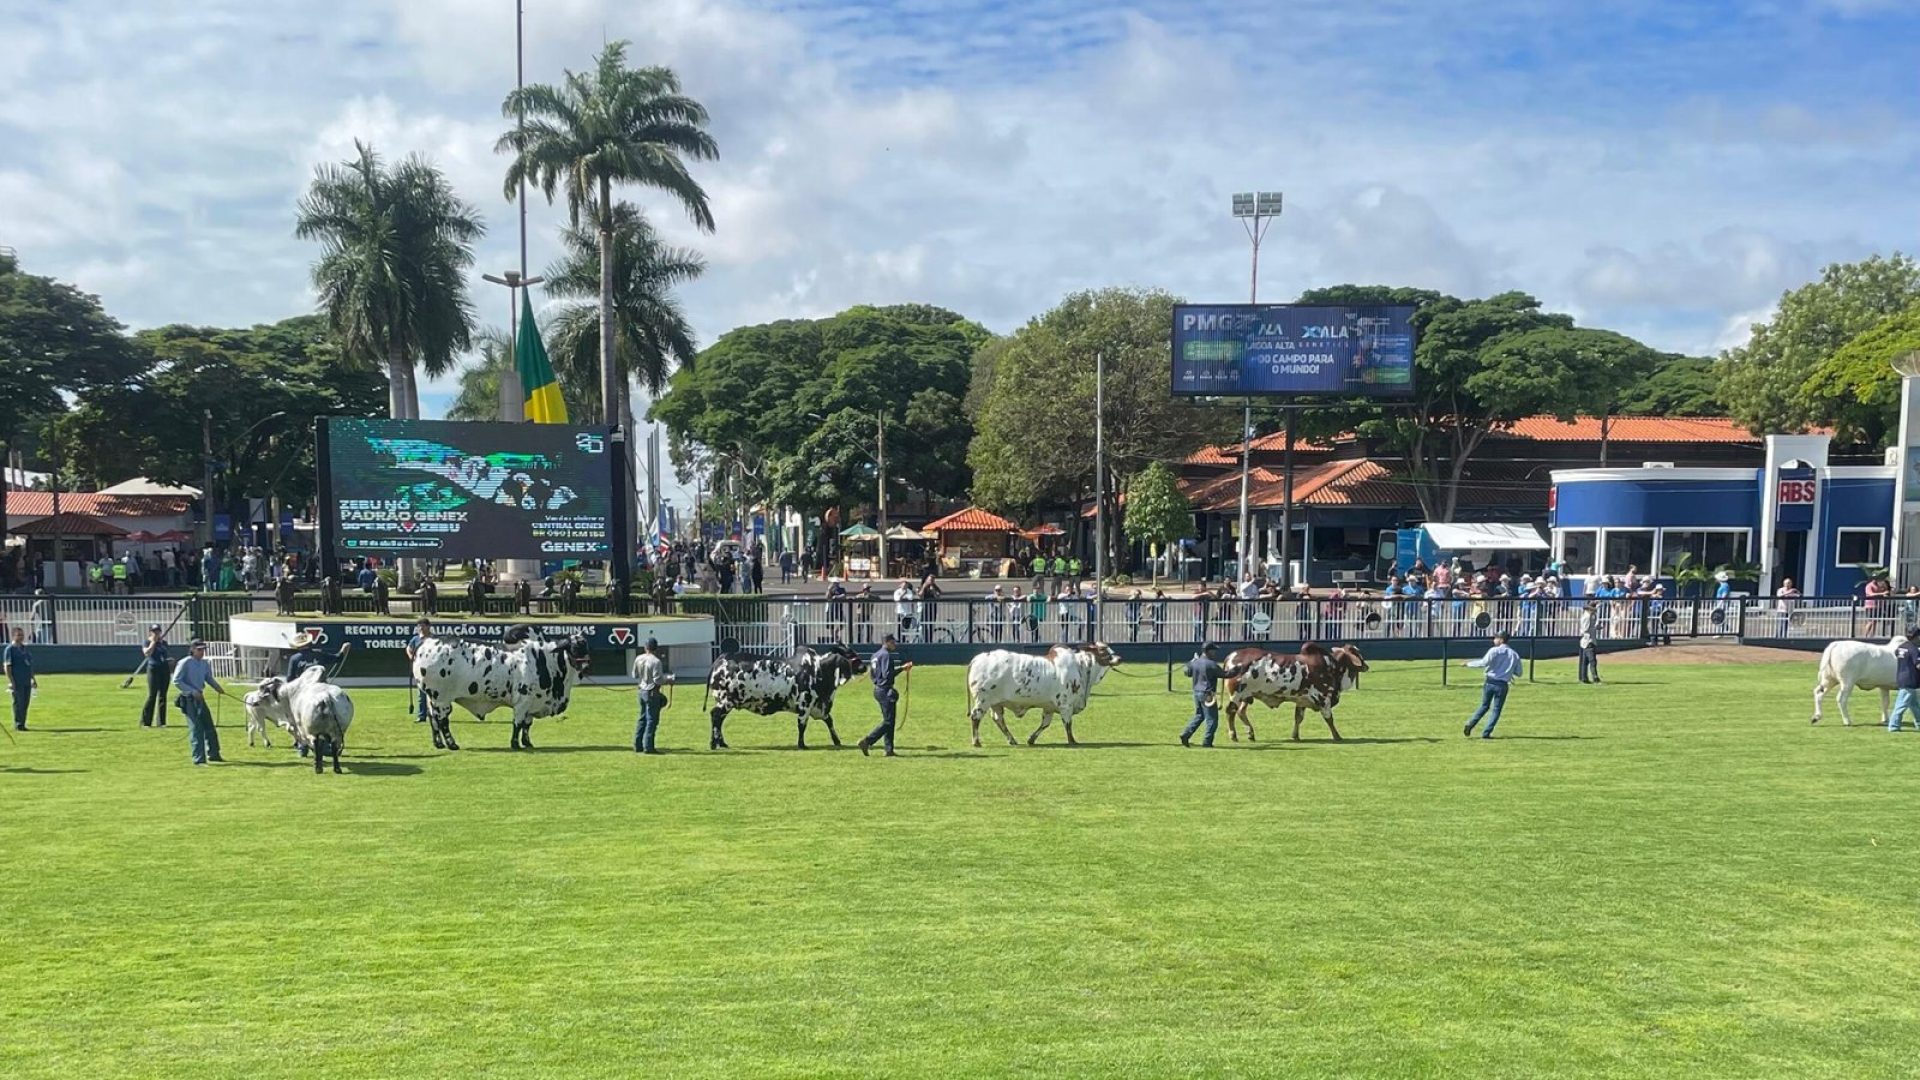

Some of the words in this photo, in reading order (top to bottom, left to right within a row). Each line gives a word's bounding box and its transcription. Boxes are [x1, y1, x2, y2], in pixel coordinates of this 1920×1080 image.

[1272, 355, 1306, 363] CAMPO
[1308, 355, 1334, 363] PARA
[1271, 365, 1279, 373] O
[1280, 365, 1319, 373] MUNDO!
[1780, 481, 1815, 502] ABS
[340, 500, 380, 509] ZEBU
[384, 500, 410, 510] NO
[341, 509, 411, 521] PADRÃO
[413, 512, 468, 521] GENEX
[345, 626, 393, 635] RECINTO
[395, 626, 410, 635] DE
[413, 624, 476, 637] AALIAÇÃO
[479, 626, 502, 635] DAS
[365, 640, 407, 649] TORRES
